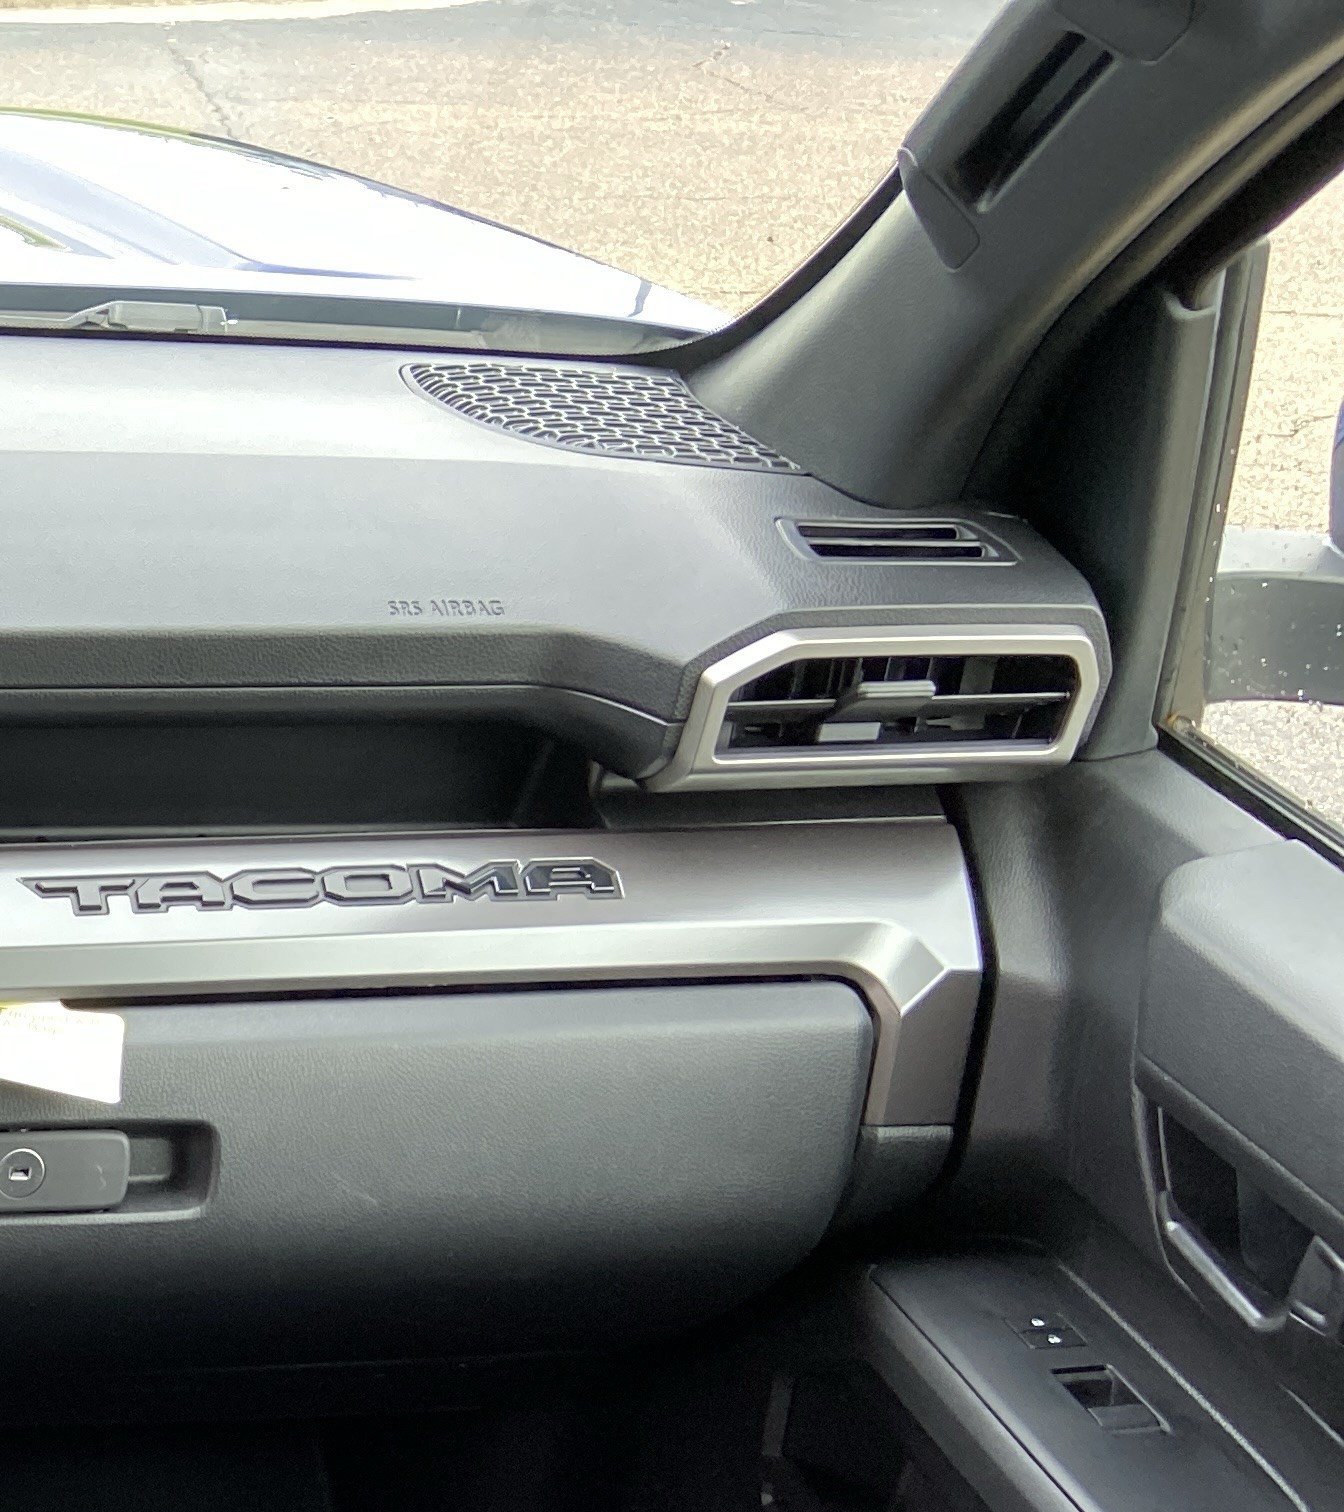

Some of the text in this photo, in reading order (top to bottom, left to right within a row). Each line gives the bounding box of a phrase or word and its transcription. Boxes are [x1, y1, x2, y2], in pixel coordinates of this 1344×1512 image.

[387, 599, 505, 616] SRS AIRBAG
[16, 858, 624, 916] TACOMA
